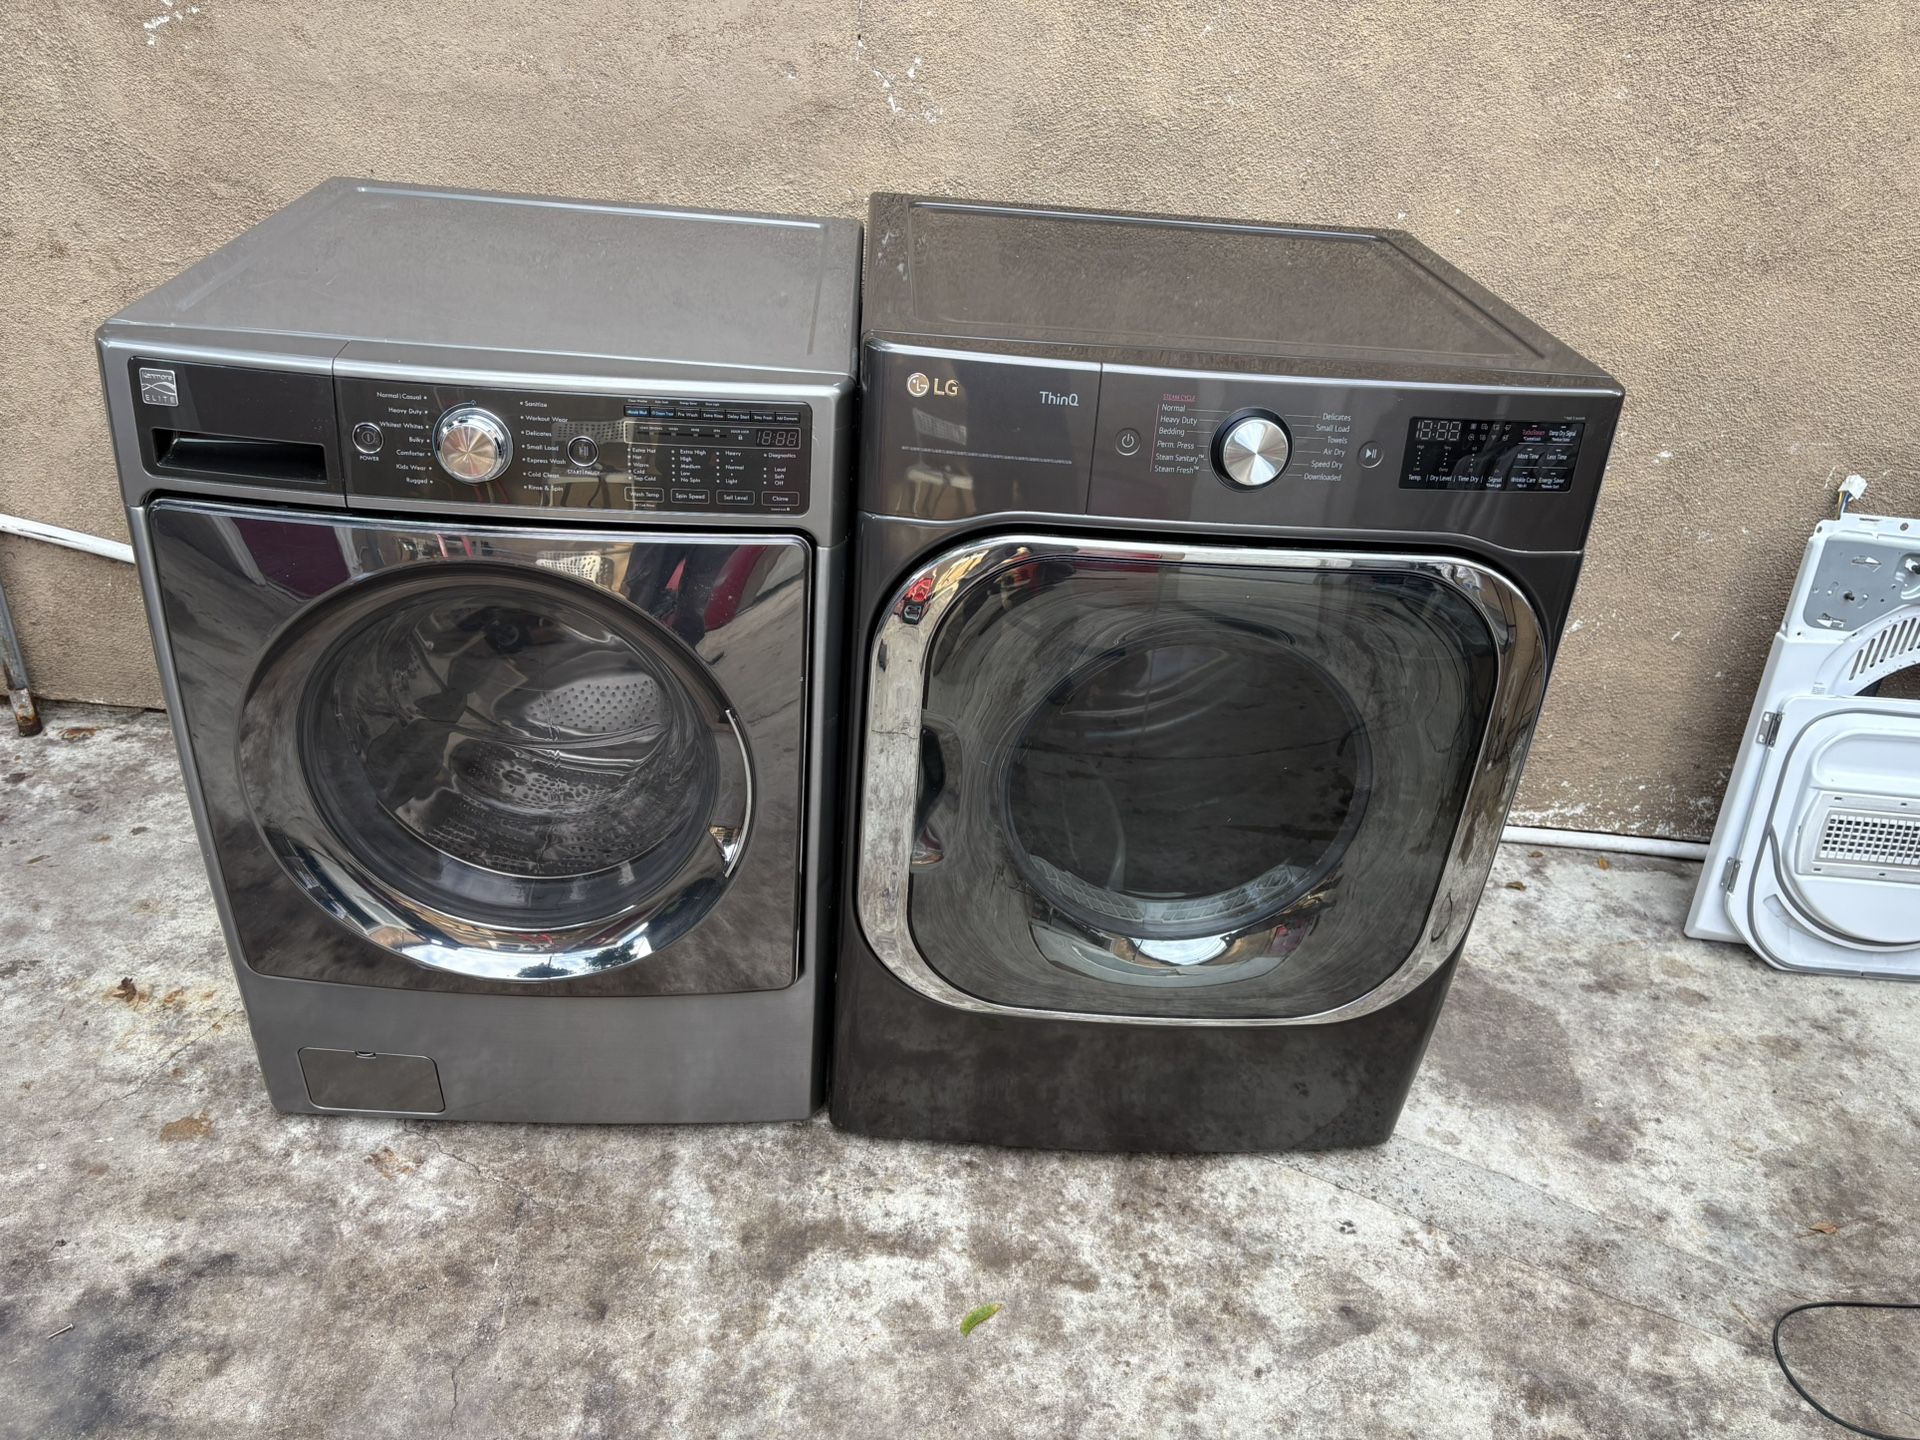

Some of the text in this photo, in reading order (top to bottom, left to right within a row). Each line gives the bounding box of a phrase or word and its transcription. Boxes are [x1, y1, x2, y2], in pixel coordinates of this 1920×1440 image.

[934, 378, 959, 396] LG
[376, 391, 398, 399] Normal
[1039, 391, 1079, 407] ThinQ
[1162, 403, 1186, 412] Normal
[1160, 415, 1197, 426] Heavy Duty
[1322, 412, 1351, 421] Delicates
[525, 429, 552, 437] Delicates
[1159, 427, 1185, 437] Bedding
[1315, 424, 1350, 433] Small Load
[408, 436, 424, 444] Bulky
[1327, 436, 1348, 444] Towels
[1176, 441, 1194, 449] Press
[1333, 448, 1345, 457] Dry
[527, 457, 548, 465] Express
[1311, 460, 1343, 470] Speed Dry
[1154, 465, 1174, 473] Steam
[406, 476, 428, 484] Rugged
[1303, 472, 1342, 481] Downloaded
